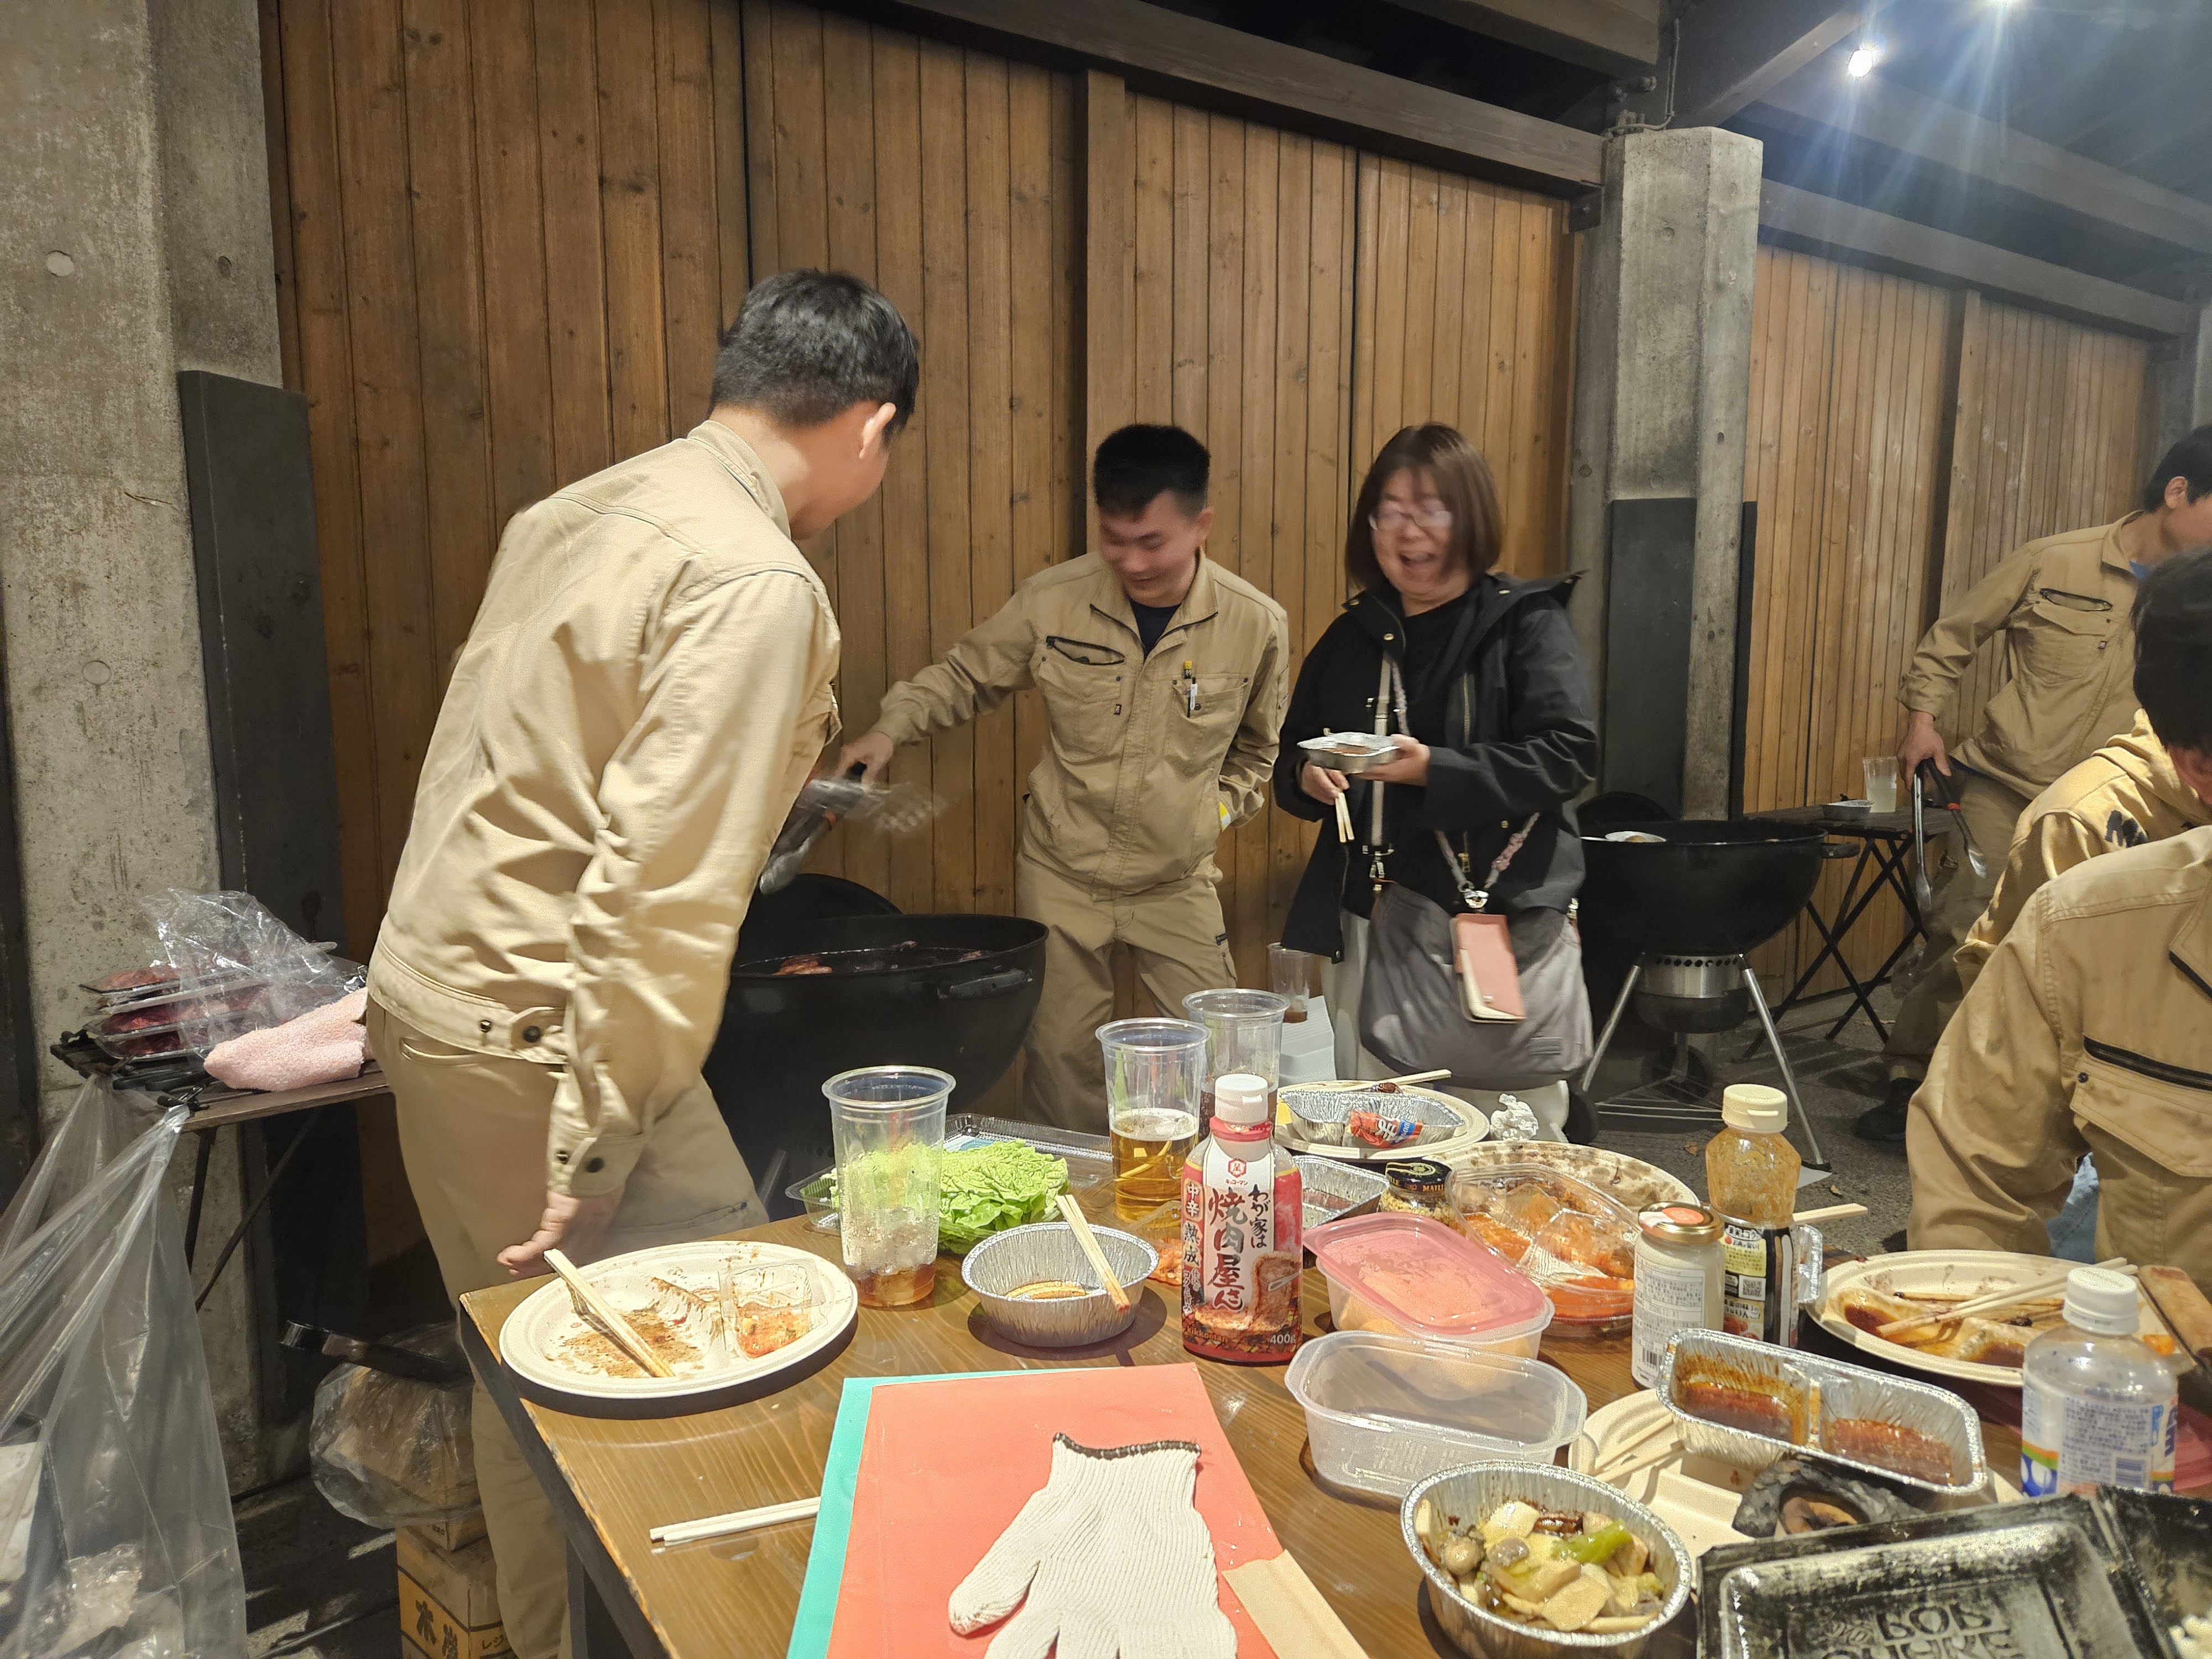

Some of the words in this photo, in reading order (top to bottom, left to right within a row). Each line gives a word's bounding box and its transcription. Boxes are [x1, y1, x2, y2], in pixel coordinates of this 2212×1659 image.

[1186, 1182, 1200, 1218] 中辛
[1248, 1183, 1271, 1248] わが家は
[1183, 1222, 1200, 1266] 熟成
[1187, 1327, 1228, 1343] kikkoman
[1270, 1333, 1296, 1344] 400g
